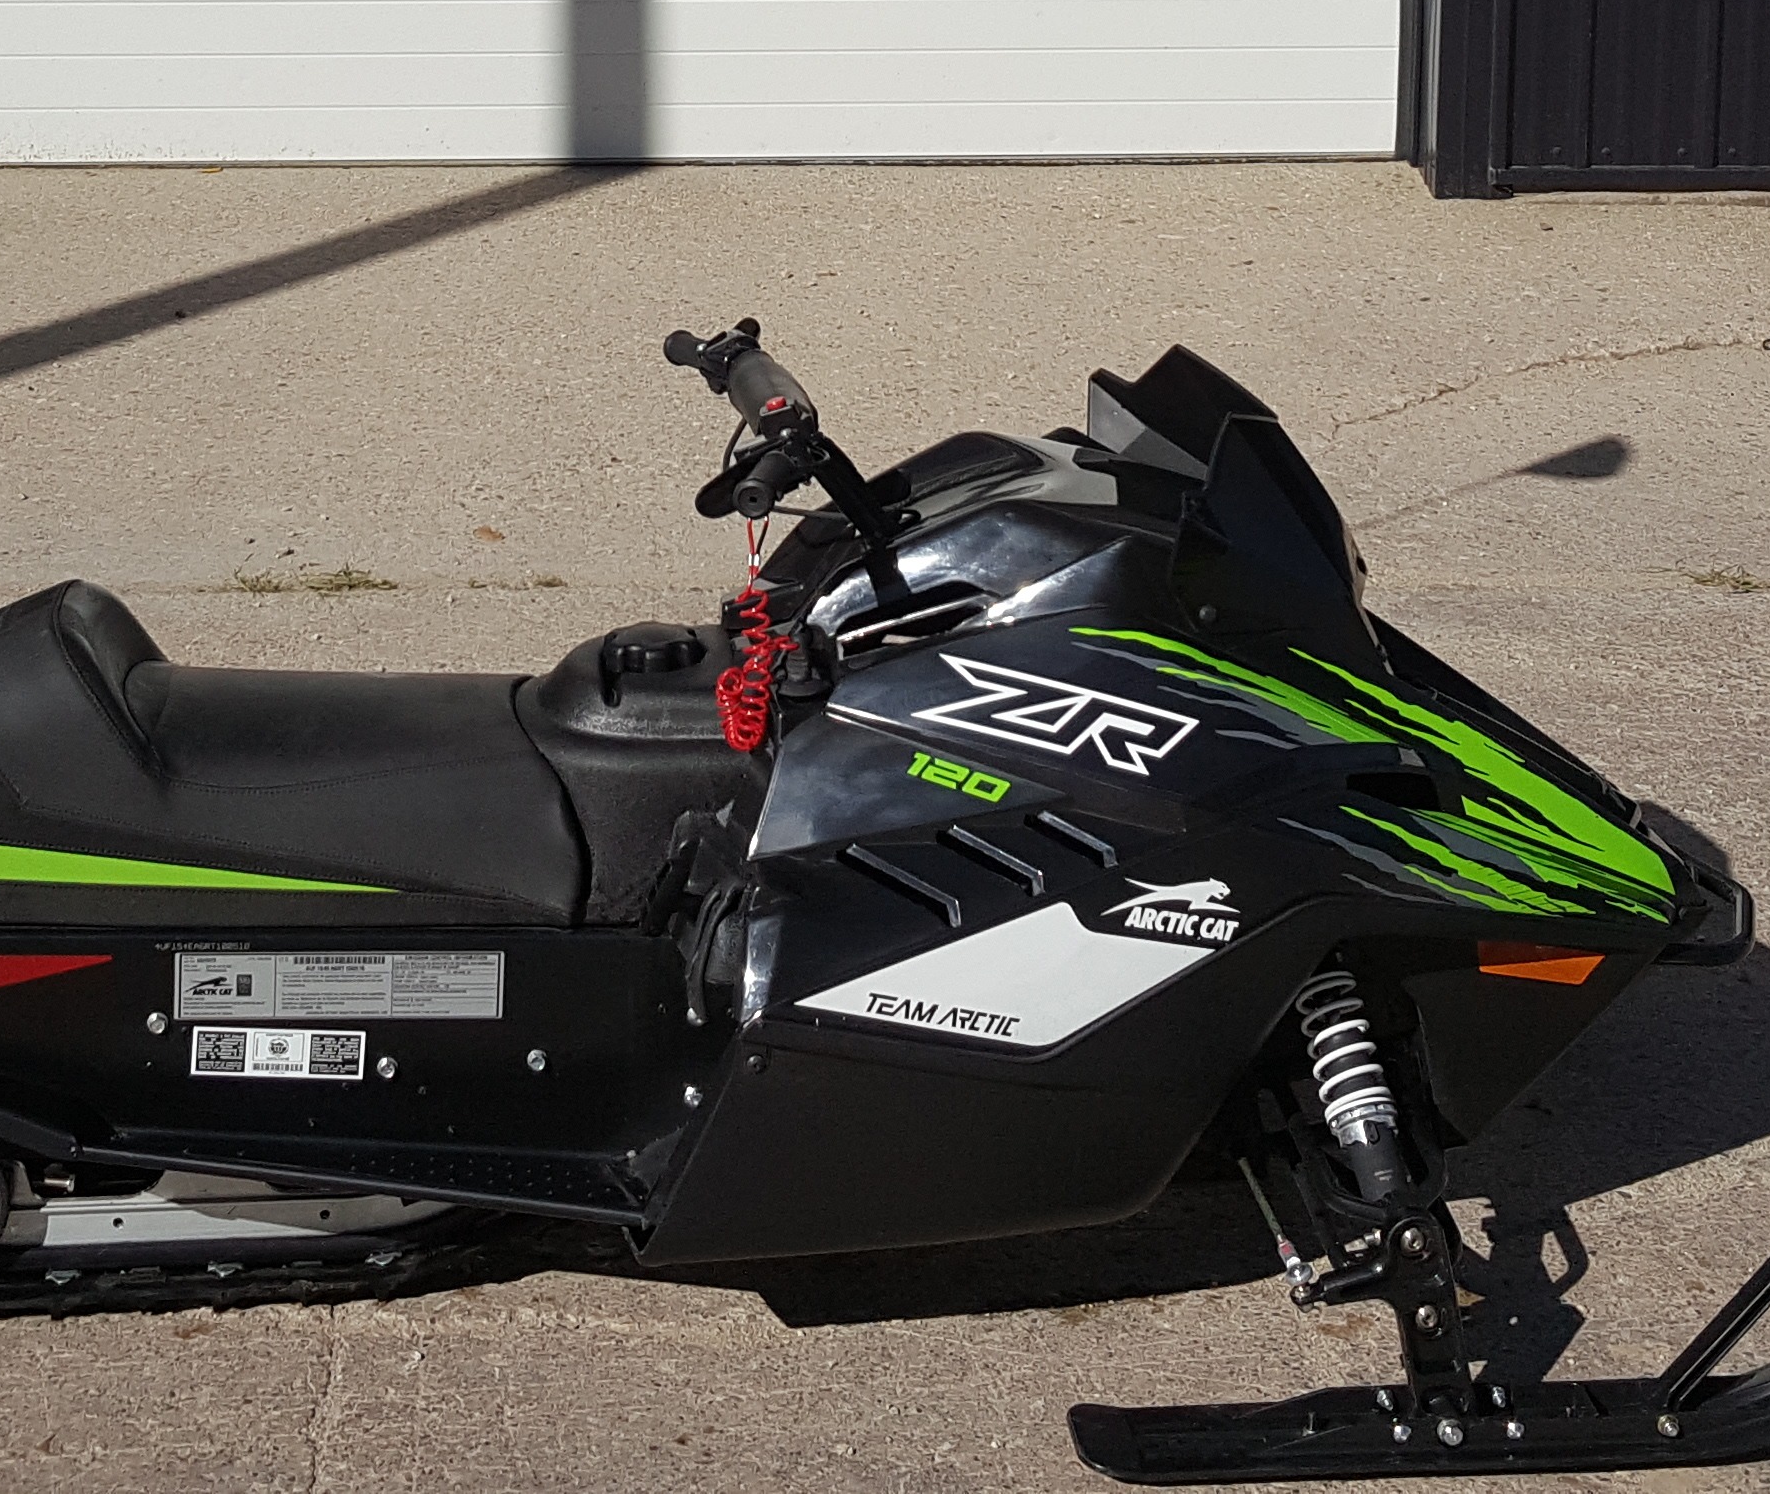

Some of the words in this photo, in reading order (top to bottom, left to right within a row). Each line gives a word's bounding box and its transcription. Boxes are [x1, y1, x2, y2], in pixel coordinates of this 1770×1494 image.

[910, 653, 1200, 775] ZR
[907, 751, 1011, 803] 120
[1124, 906, 1199, 936] ARCTIC
[1199, 917, 1239, 941] CAT
[192, 988, 217, 996] ARCTIC
[219, 988, 233, 996] CAT
[866, 992, 939, 1023] TEAM
[937, 1007, 1021, 1037] ARCTIC
